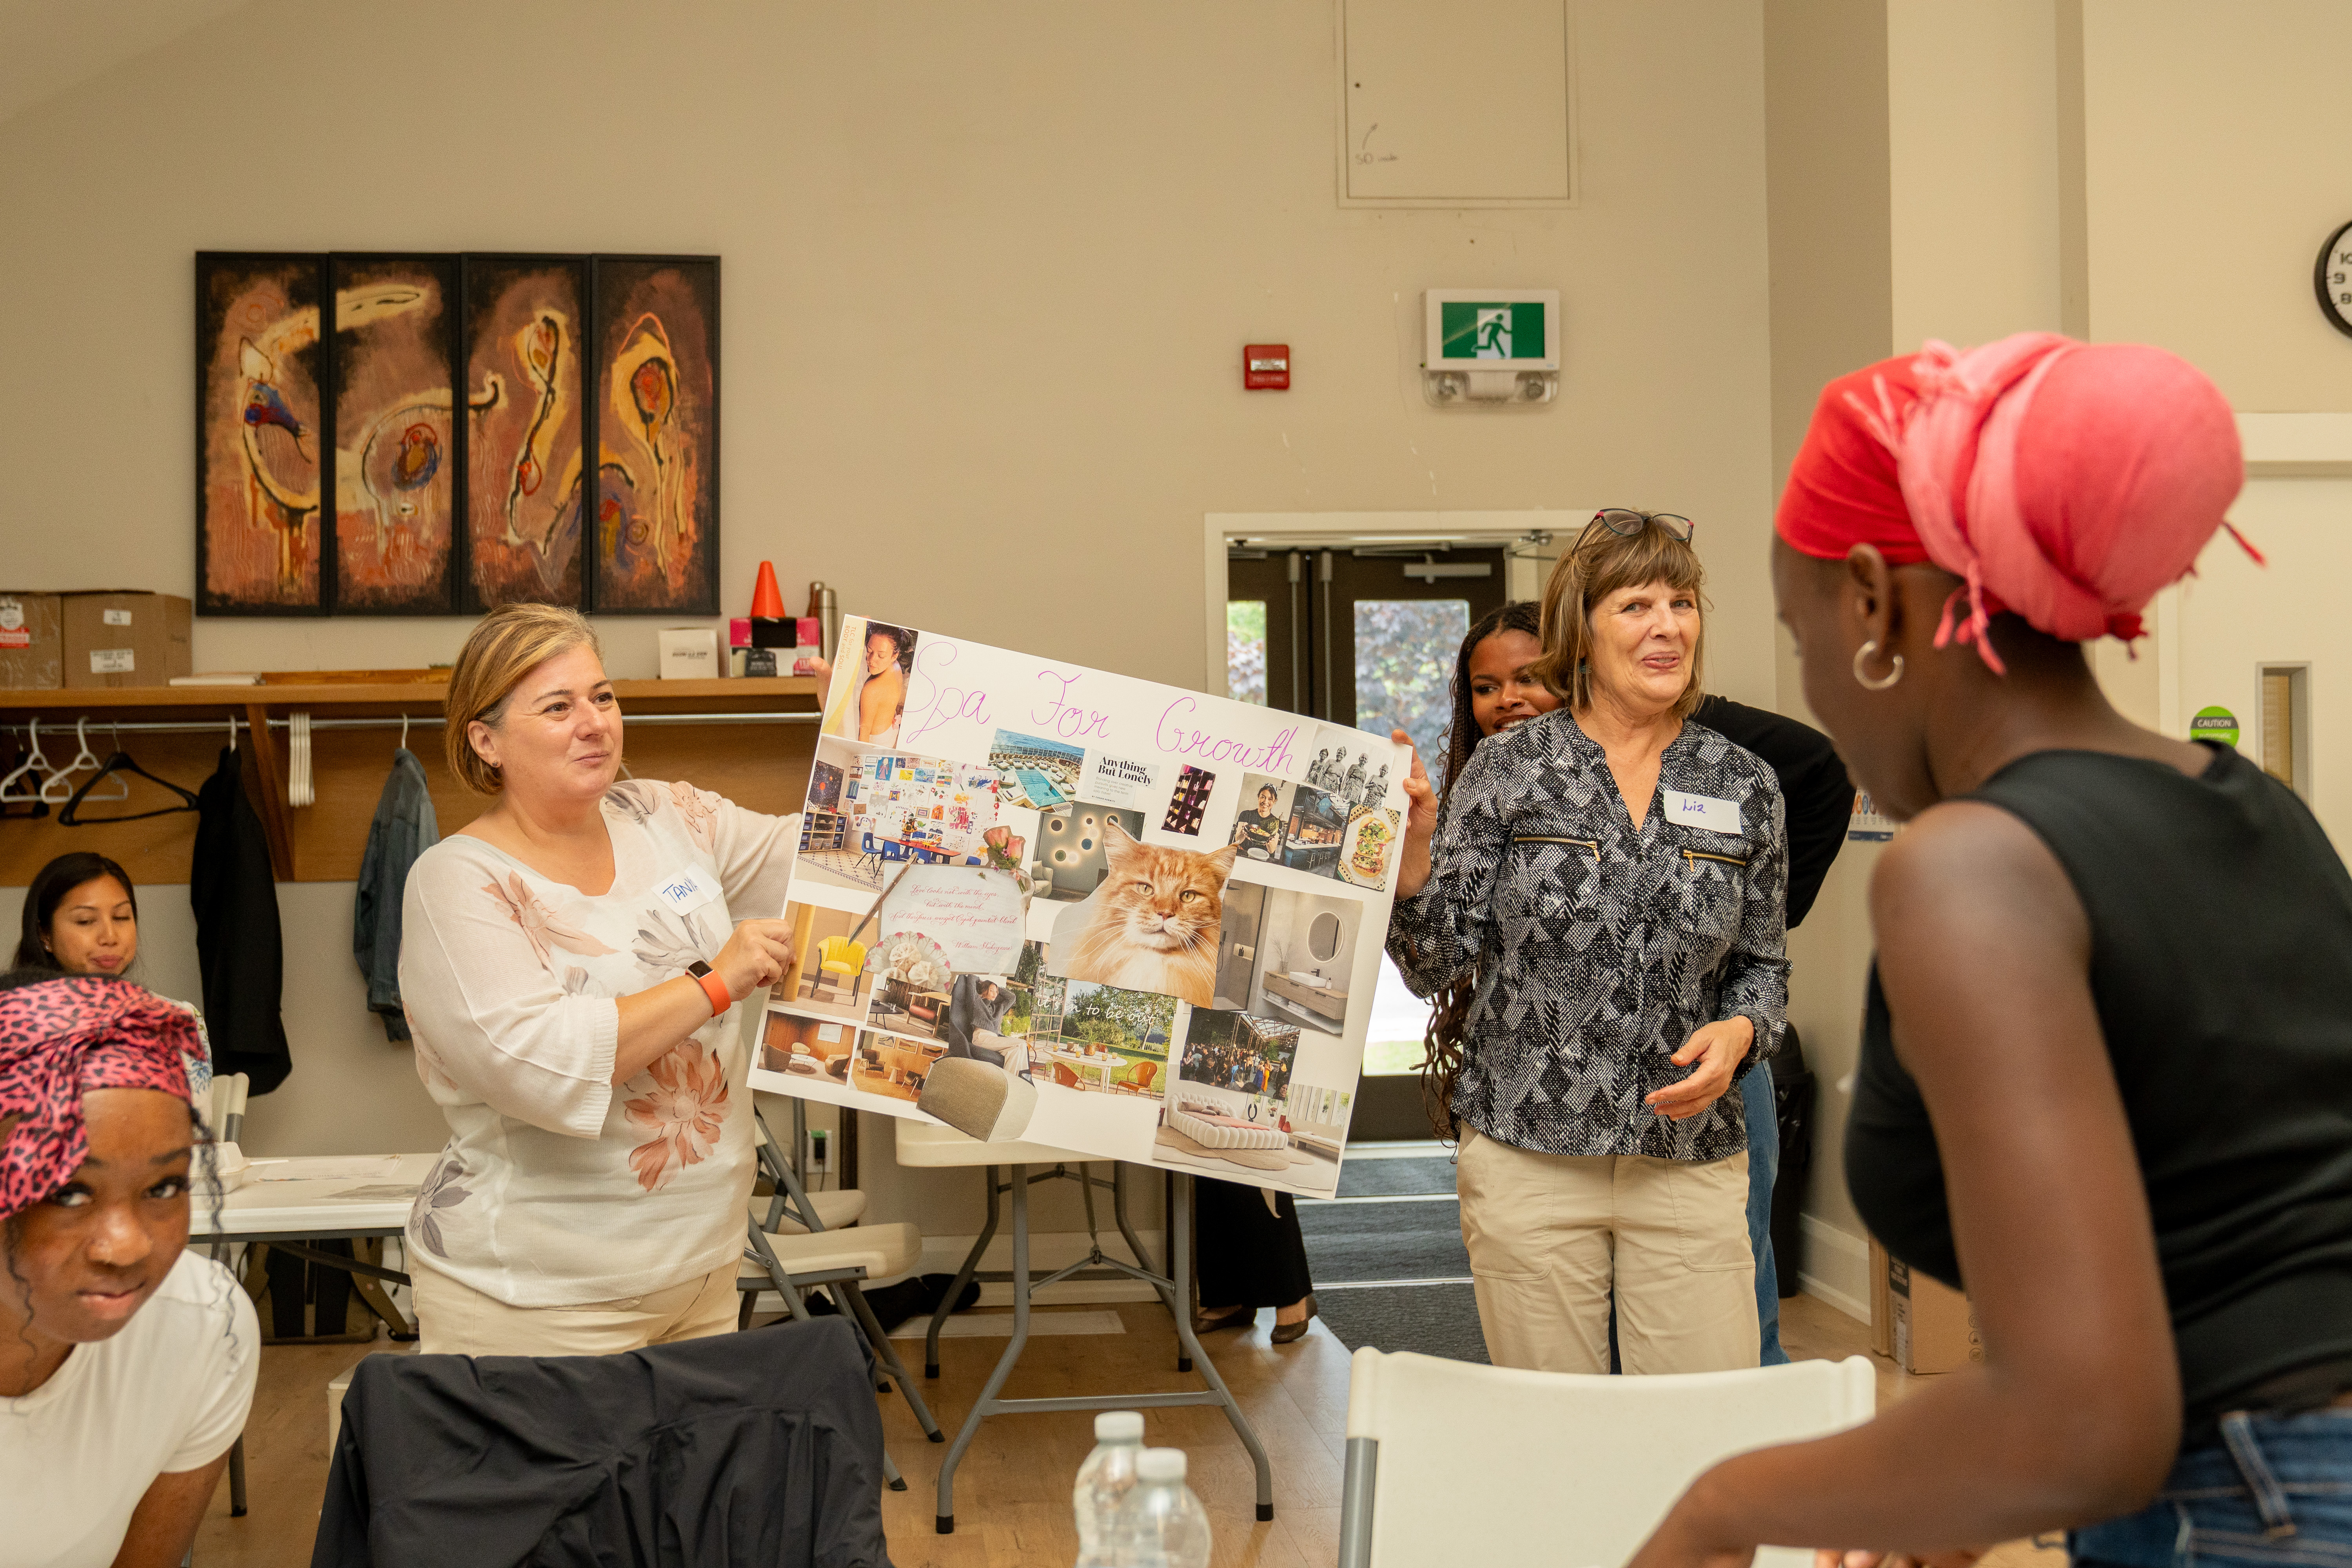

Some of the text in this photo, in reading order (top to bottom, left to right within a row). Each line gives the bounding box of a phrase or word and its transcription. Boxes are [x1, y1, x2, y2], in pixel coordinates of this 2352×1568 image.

[2334, 272, 2345, 284] 9
[2341, 292, 2352, 304] 8
[903, 641, 1299, 774] Spa For Growth
[2198, 719, 2230, 727] CAUTION
[1100, 756, 1147, 776] Anything
[1098, 764, 1153, 786] But Lonely
[1682, 799, 1706, 814] Liz
[910, 884, 926, 896] Love
[924, 898, 939, 907] but
[889, 910, 906, 922] And
[932, 914, 955, 926] winged
[956, 913, 974, 926] Cupid
[969, 915, 998, 927] painted
[998, 915, 1018, 924] blind
[952, 940, 1013, 955] William Shakespeare
[1086, 1003, 1100, 1015] to
[1106, 1006, 1124, 1019] be
[1129, 1014, 1156, 1024] out
